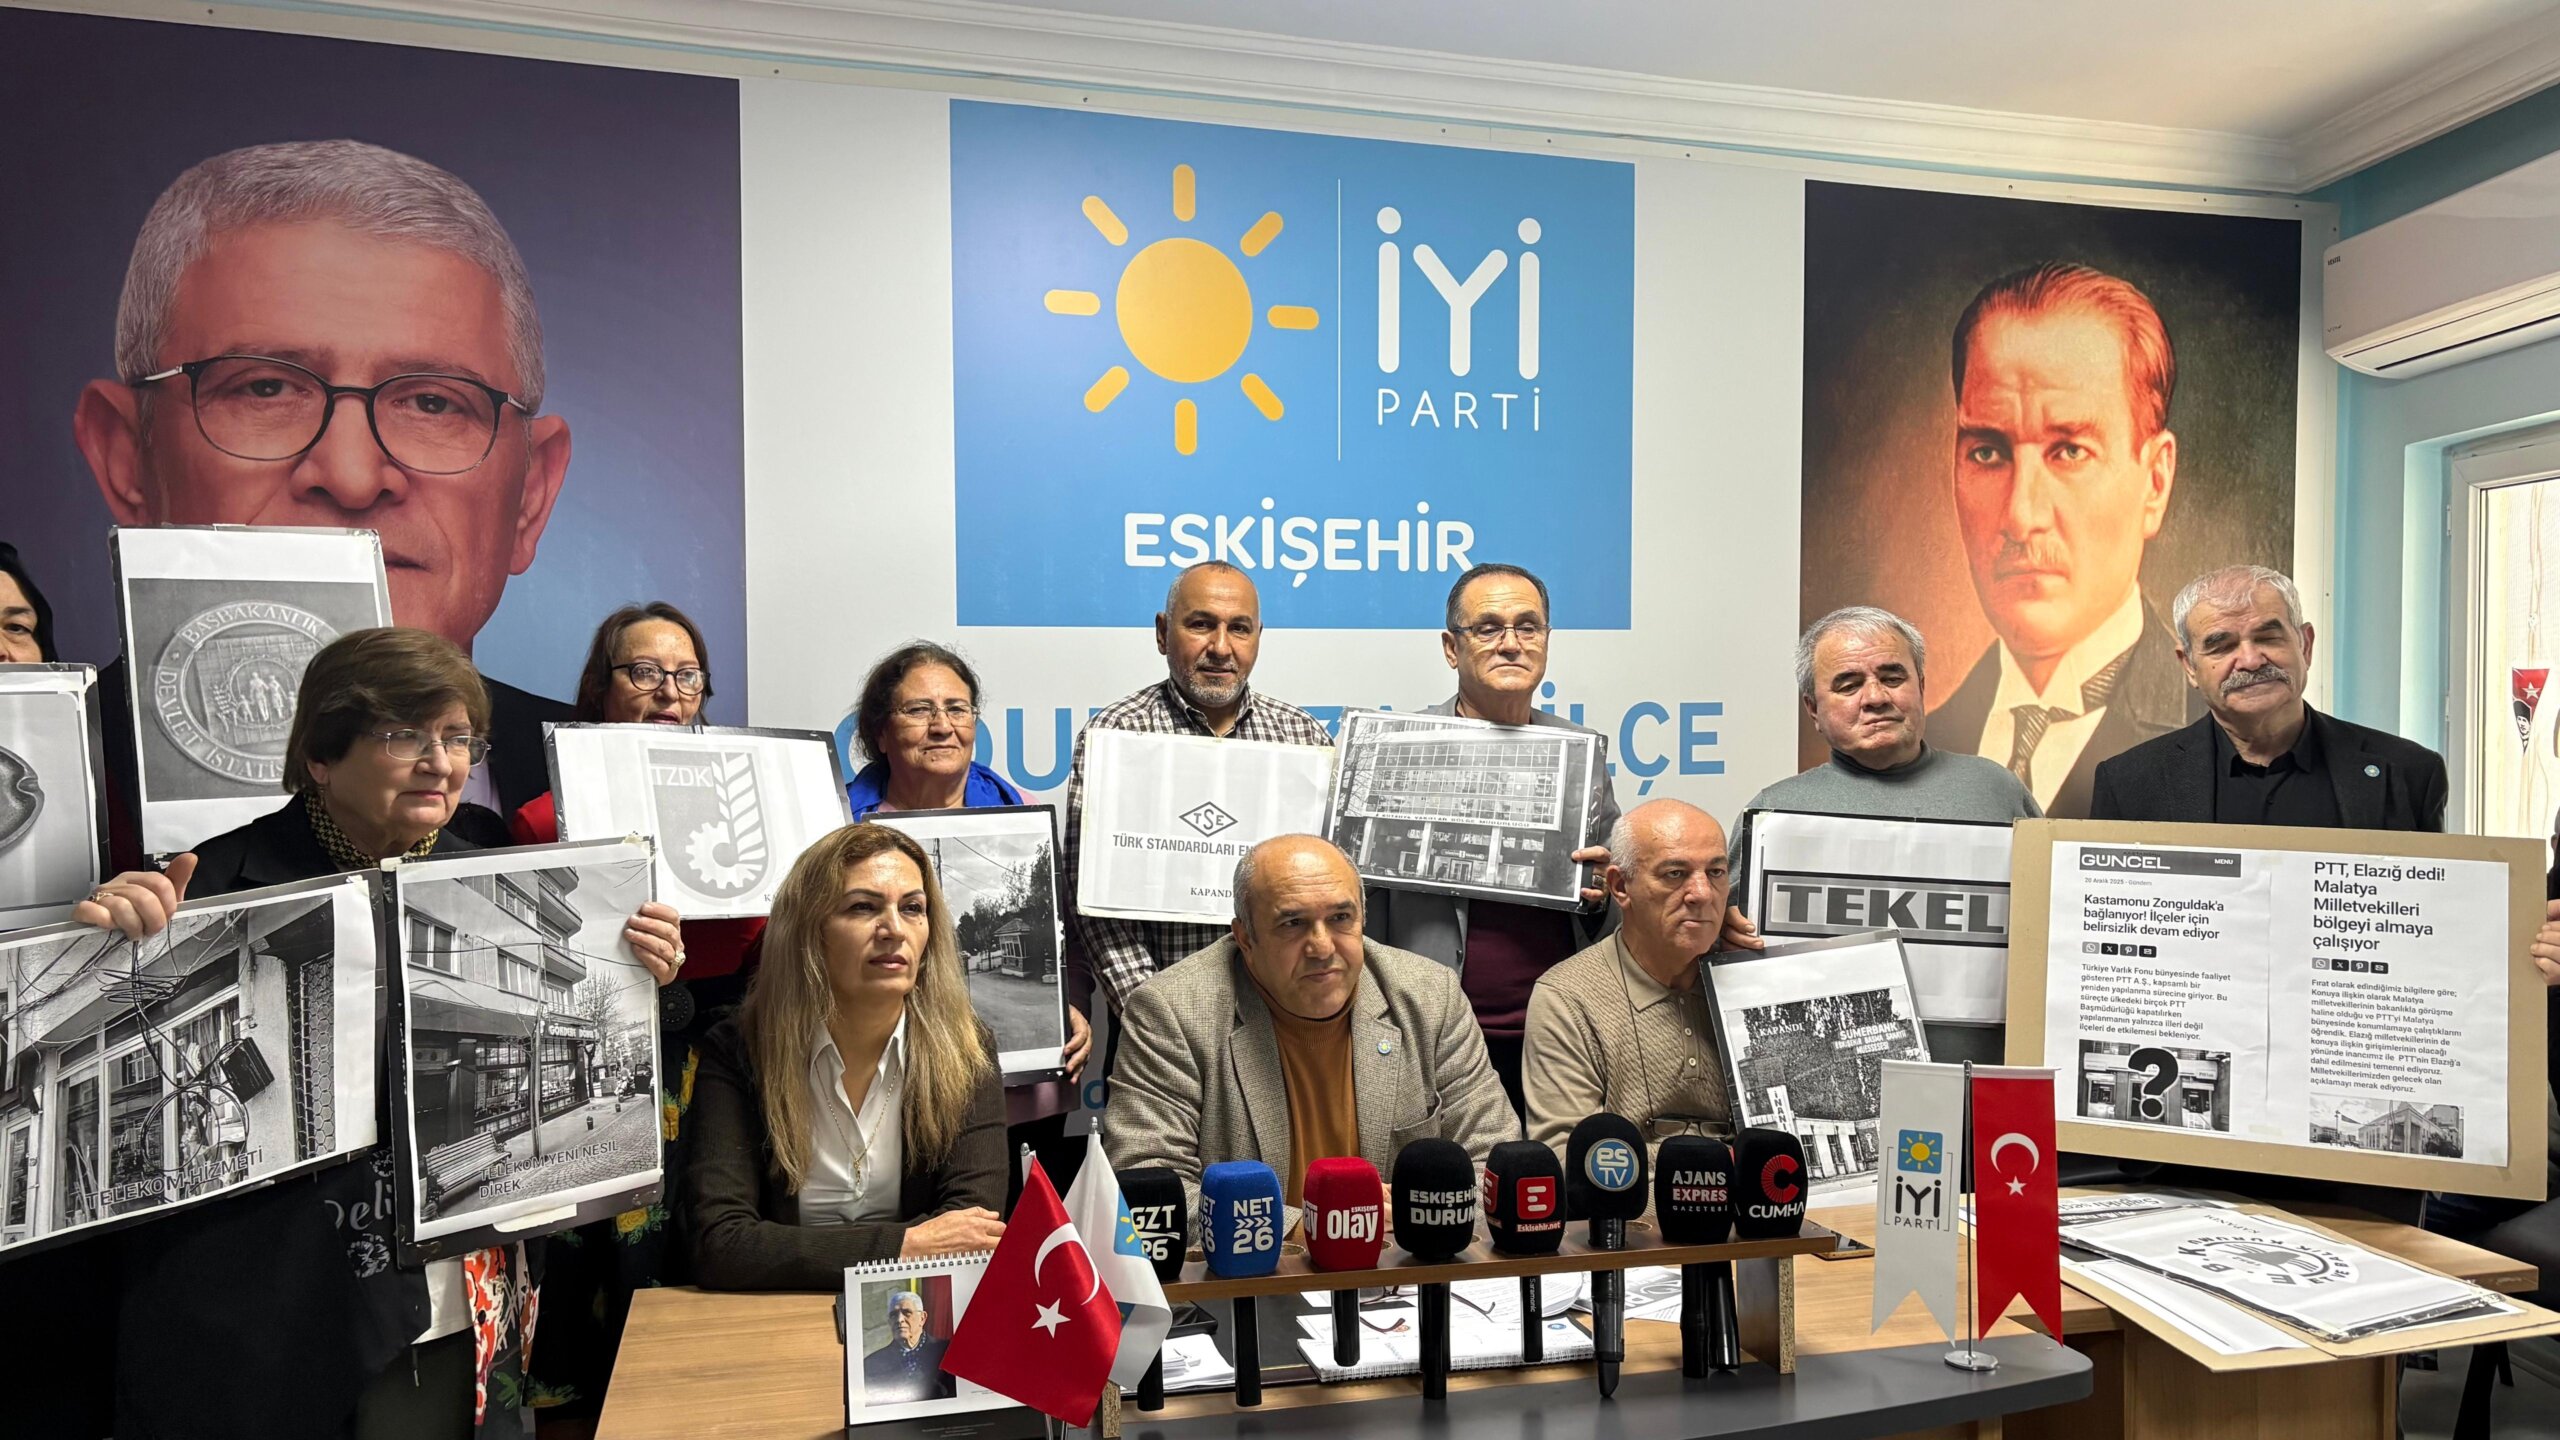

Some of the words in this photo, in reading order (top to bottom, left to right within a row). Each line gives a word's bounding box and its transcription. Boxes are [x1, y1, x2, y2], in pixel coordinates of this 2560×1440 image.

[1377, 206, 1541, 380] İYİ
[1378, 387, 1541, 432] PARTİ
[1124, 496, 1476, 588] ESKİŞEHİR
[182, 604, 324, 644] BAŞBAKANLIK
[158, 671, 204, 746] DEVLET
[650, 766, 714, 788] TZDK
[1193, 809, 1224, 830] TSE
[1112, 834, 1144, 849] TÜRK
[1146, 838, 1234, 856] STANDARDLARI
[2082, 854, 2170, 870] GÜNCEL
[2315, 862, 2349, 878] PTT,
[2354, 864, 2401, 881] Elazığ
[2407, 866, 2445, 881] dedi!
[1190, 888, 1234, 898] KAPAND
[2314, 880, 2377, 897] Malatya
[1776, 884, 2004, 934] TEKEL
[2085, 894, 2149, 907] Kastamonu
[2153, 898, 2224, 911] Zonguldak'a
[2314, 898, 2419, 916] Milletvekilleri
[2084, 908, 2147, 922] bağlanıyor!
[2150, 910, 2185, 923] İlçeler
[2189, 913, 2209, 925] için
[2084, 921, 2137, 934] belirsizlik
[2140, 925, 2179, 937] devam
[2183, 927, 2219, 940] ediyor
[2314, 915, 2370, 934] bölgeyi
[2375, 920, 2433, 938] almaya
[2313, 935, 2380, 952] çalışıyor
[2082, 964, 2109, 973] Türkiye
[2134, 967, 2153, 975] Fonu
[2156, 969, 2199, 979] bünyesinde
[2202, 972, 2230, 981] faaliyet
[2082, 974, 2114, 983] gösteren
[2153, 979, 2188, 988] kapsamlı
[2081, 984, 2110, 993] yeniden
[2112, 986, 2150, 995] yapılanma
[2153, 989, 2186, 998] sürecine
[2312, 989, 2340, 998] Konuya
[2367, 993, 2391, 1001] olarak
[2393, 996, 2424, 1005] Malatya
[2331, 981, 2355, 989] olarak
[2357, 983, 2402, 992] edindiğimiz
[2404, 986, 2435, 996] bilgilere
[2081, 994, 2108, 1003] süreçte
[2110, 996, 2142, 1004] ülkedeki
[2144, 998, 2167, 1007] birçok
[2080, 1003, 2134, 1015] Başmüdürlüğü
[2137, 1007, 2182, 1018] kapatılırken
[2337, 1011, 2363, 1020] olduğu
[2403, 1016, 2434, 1025] Malatya
[2080, 1014, 2130, 1023] yapılanmanın
[2132, 1017, 2163, 1026] yalnızca
[2166, 1020, 2182, 1028] illeri
[2184, 1022, 2203, 1031] değil
[2311, 1019, 2355, 1029] bünyesinde
[2118, 1027, 2157, 1036] etkilemesi
[2311, 1038, 2338, 1047] konuya
[2311, 1048, 2343, 1057] yönünde
[2311, 1057, 2329, 1065] dahil
[2331, 1059, 2371, 1069] edilmesini
[2373, 1063, 2405, 1072] temenni
[2393, 1075, 2422, 1083] gelecek
[480, 1157, 545, 1181] TELEKOM
[547, 1146, 579, 1165] YENİ
[85, 1174, 185, 1210] TELEKOM
[190, 1145, 264, 1185] HİZMETİ
[1598, 1167, 1628, 1186] TV
[1672, 1170, 1726, 1186] AJANS
[1672, 1188, 1728, 1202] EXPRES
[1896, 1176, 1942, 1218] İYİ
[1233, 1196, 1274, 1218] NET
[1672, 1204, 1728, 1212] GAZETESİ
[1326, 1209, 1379, 1243] Olay
[1232, 1226, 1274, 1254] 26
